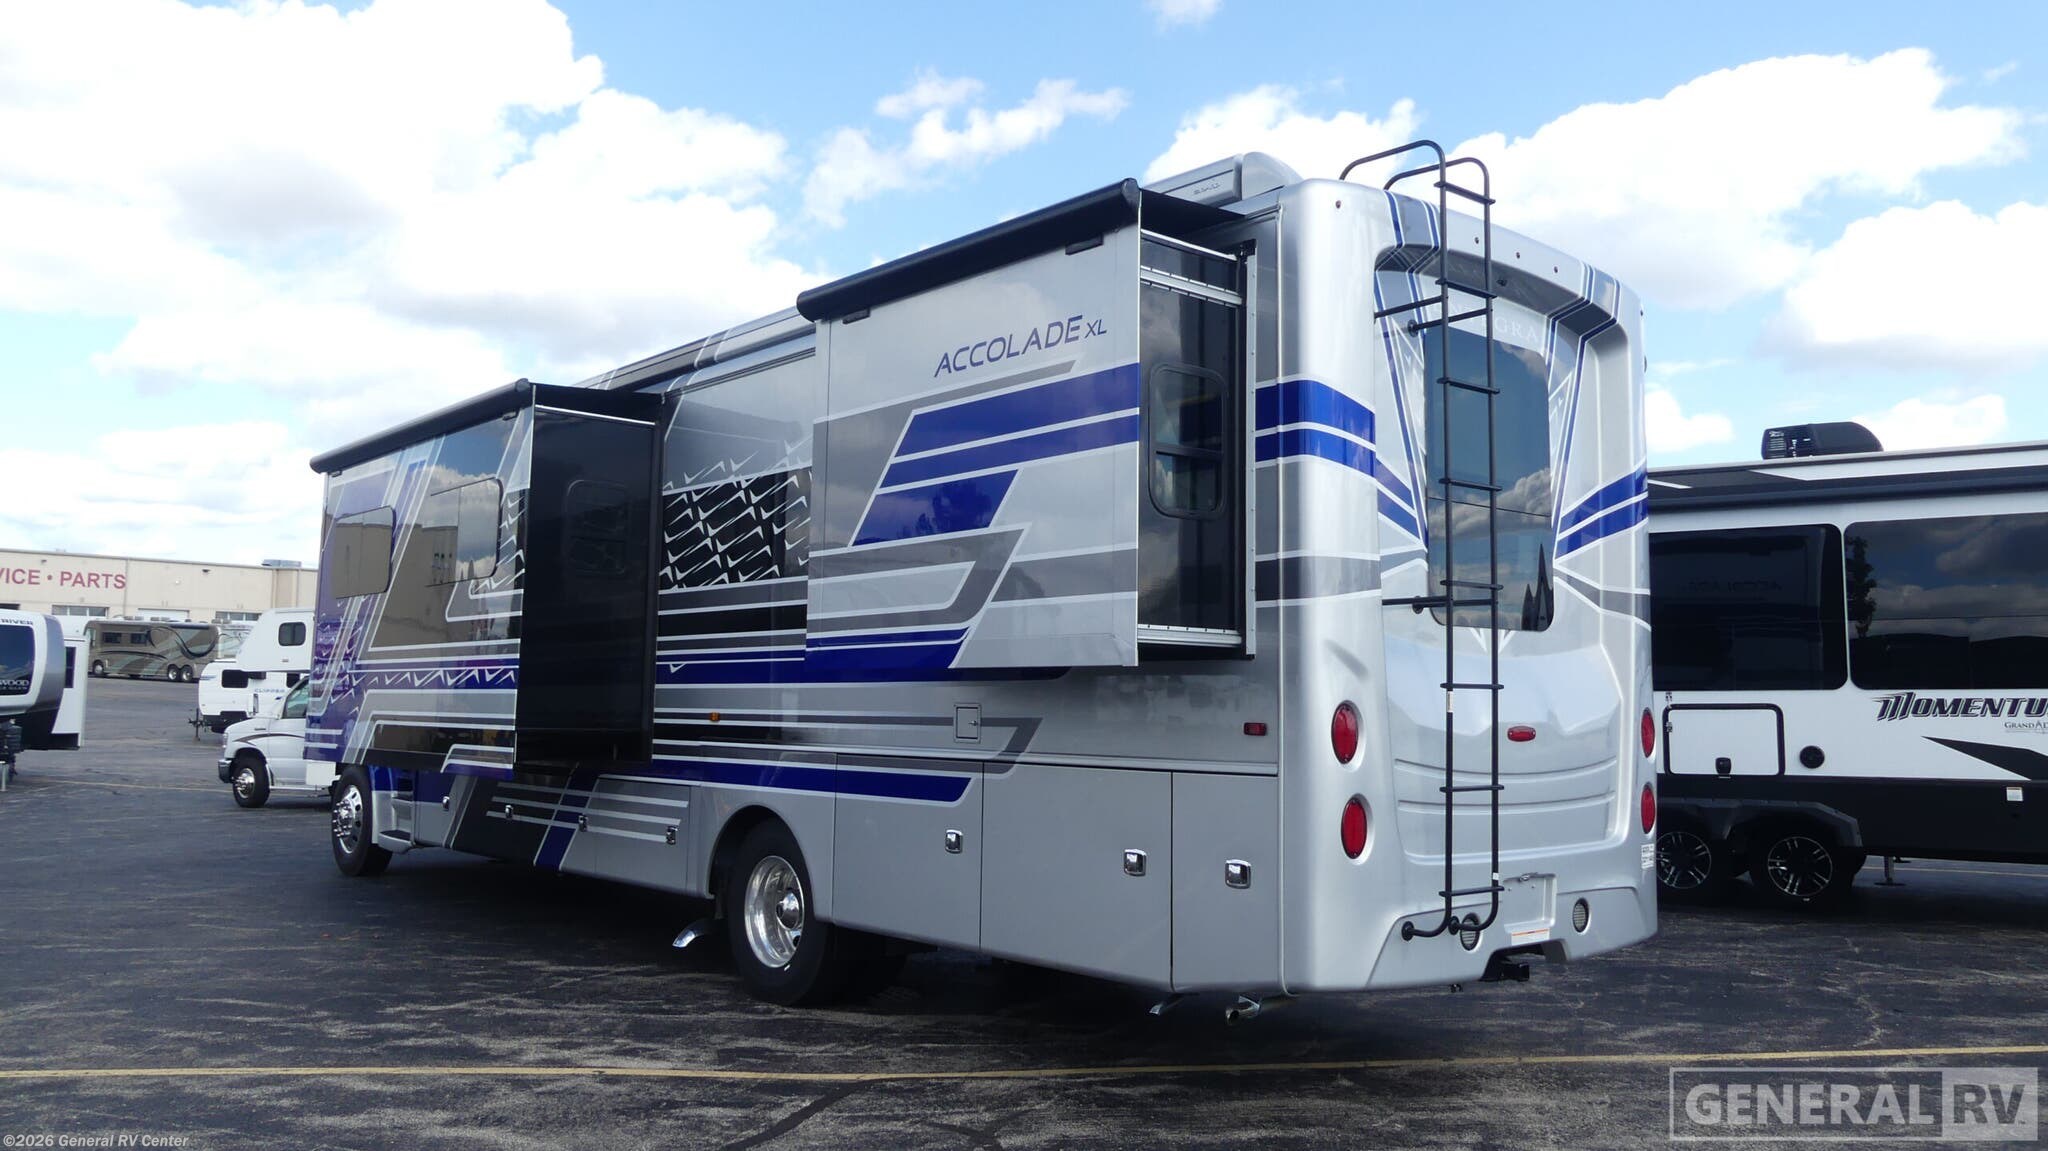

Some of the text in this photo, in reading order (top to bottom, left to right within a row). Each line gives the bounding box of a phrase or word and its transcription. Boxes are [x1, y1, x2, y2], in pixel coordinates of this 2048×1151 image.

[933, 315, 1107, 377] ACCOLADE XL
[60, 571, 126, 589] PARTS
